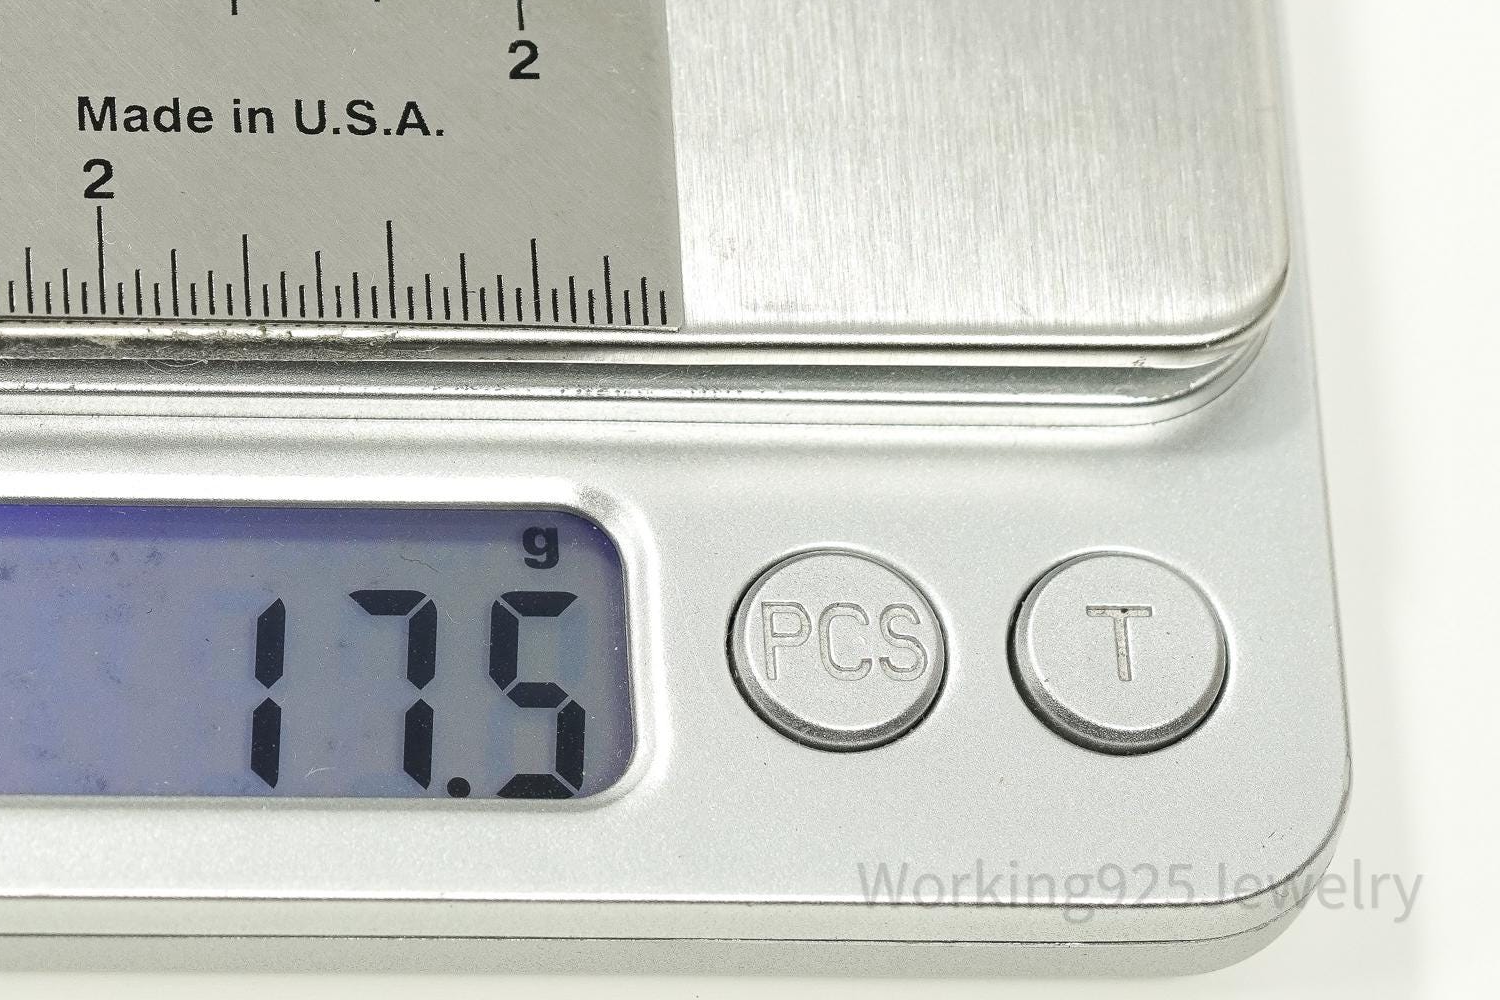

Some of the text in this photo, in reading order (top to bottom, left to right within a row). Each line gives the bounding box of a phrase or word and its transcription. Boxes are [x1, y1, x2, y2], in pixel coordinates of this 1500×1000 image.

[508, 39, 541, 80] 2
[77, 96, 446, 137] Made in U.S.A.
[82, 158, 115, 200] 2
[521, 525, 560, 570] g
[761, 601, 928, 681] PCS
[1085, 604, 1153, 682] T
[250, 589, 587, 800] 17.5
